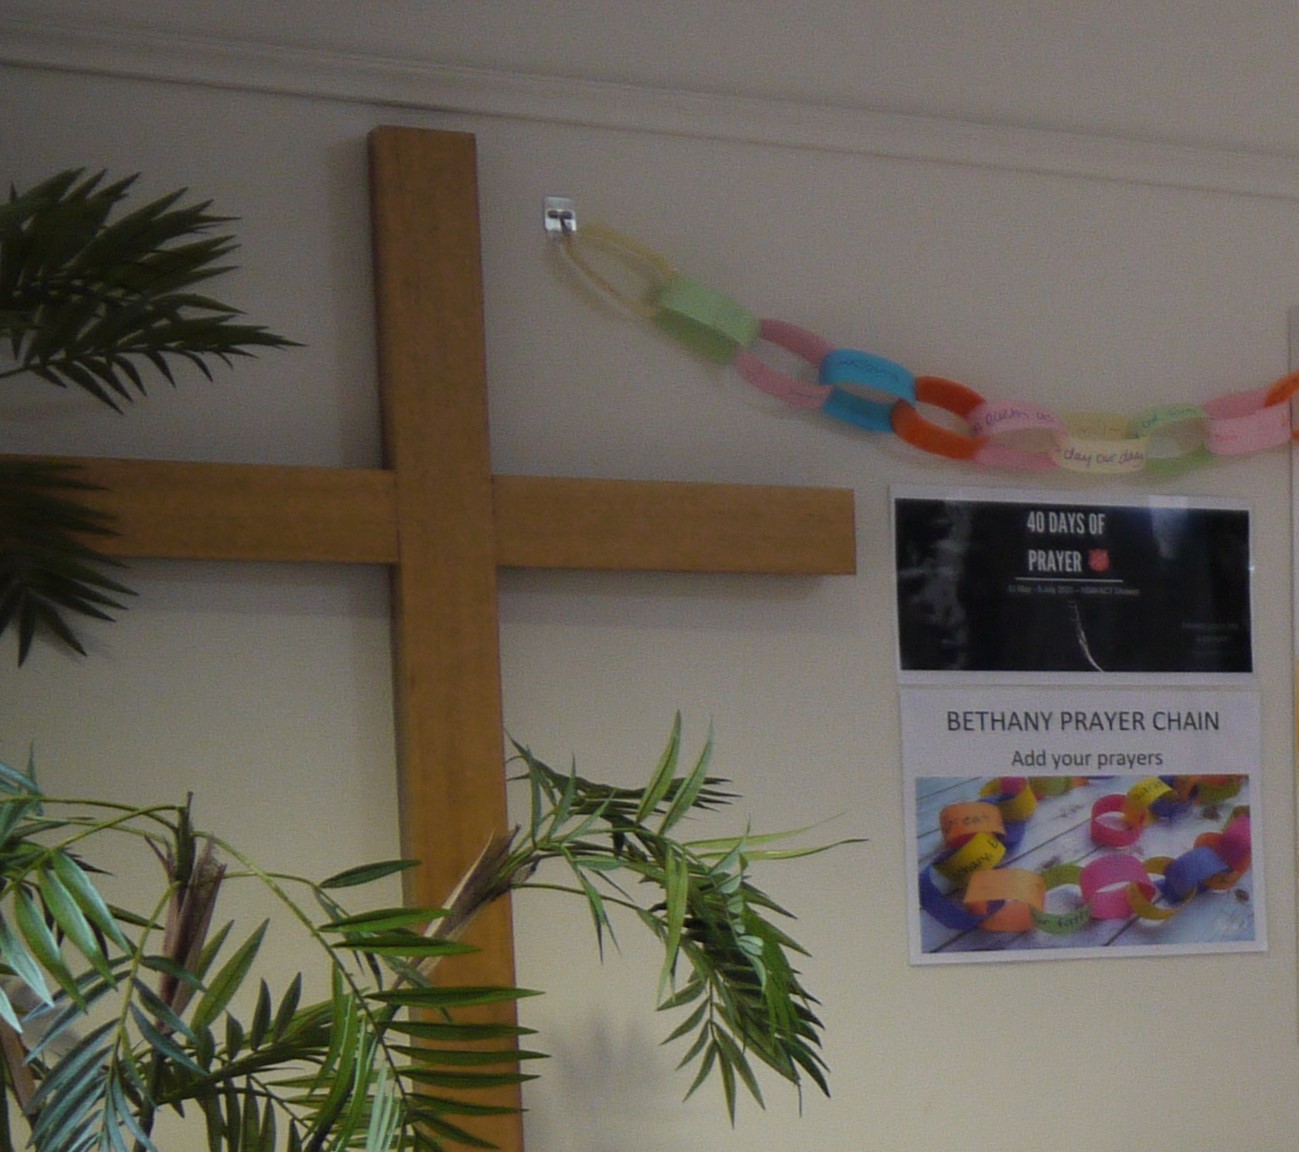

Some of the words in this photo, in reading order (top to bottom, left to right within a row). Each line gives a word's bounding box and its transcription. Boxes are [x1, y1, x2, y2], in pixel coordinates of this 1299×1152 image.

[1027, 511, 1045, 532] 40
[1049, 511, 1085, 534] DAYS
[1089, 513, 1106, 535] OF
[1027, 549, 1082, 573] PRAYER
[947, 710, 1052, 731] BETHANY
[1060, 710, 1146, 731] PRAYER
[1152, 710, 1220, 731] CHAIN
[1011, 750, 1046, 767] Add
[1050, 753, 1092, 770] your
[1097, 751, 1164, 770] prayers
